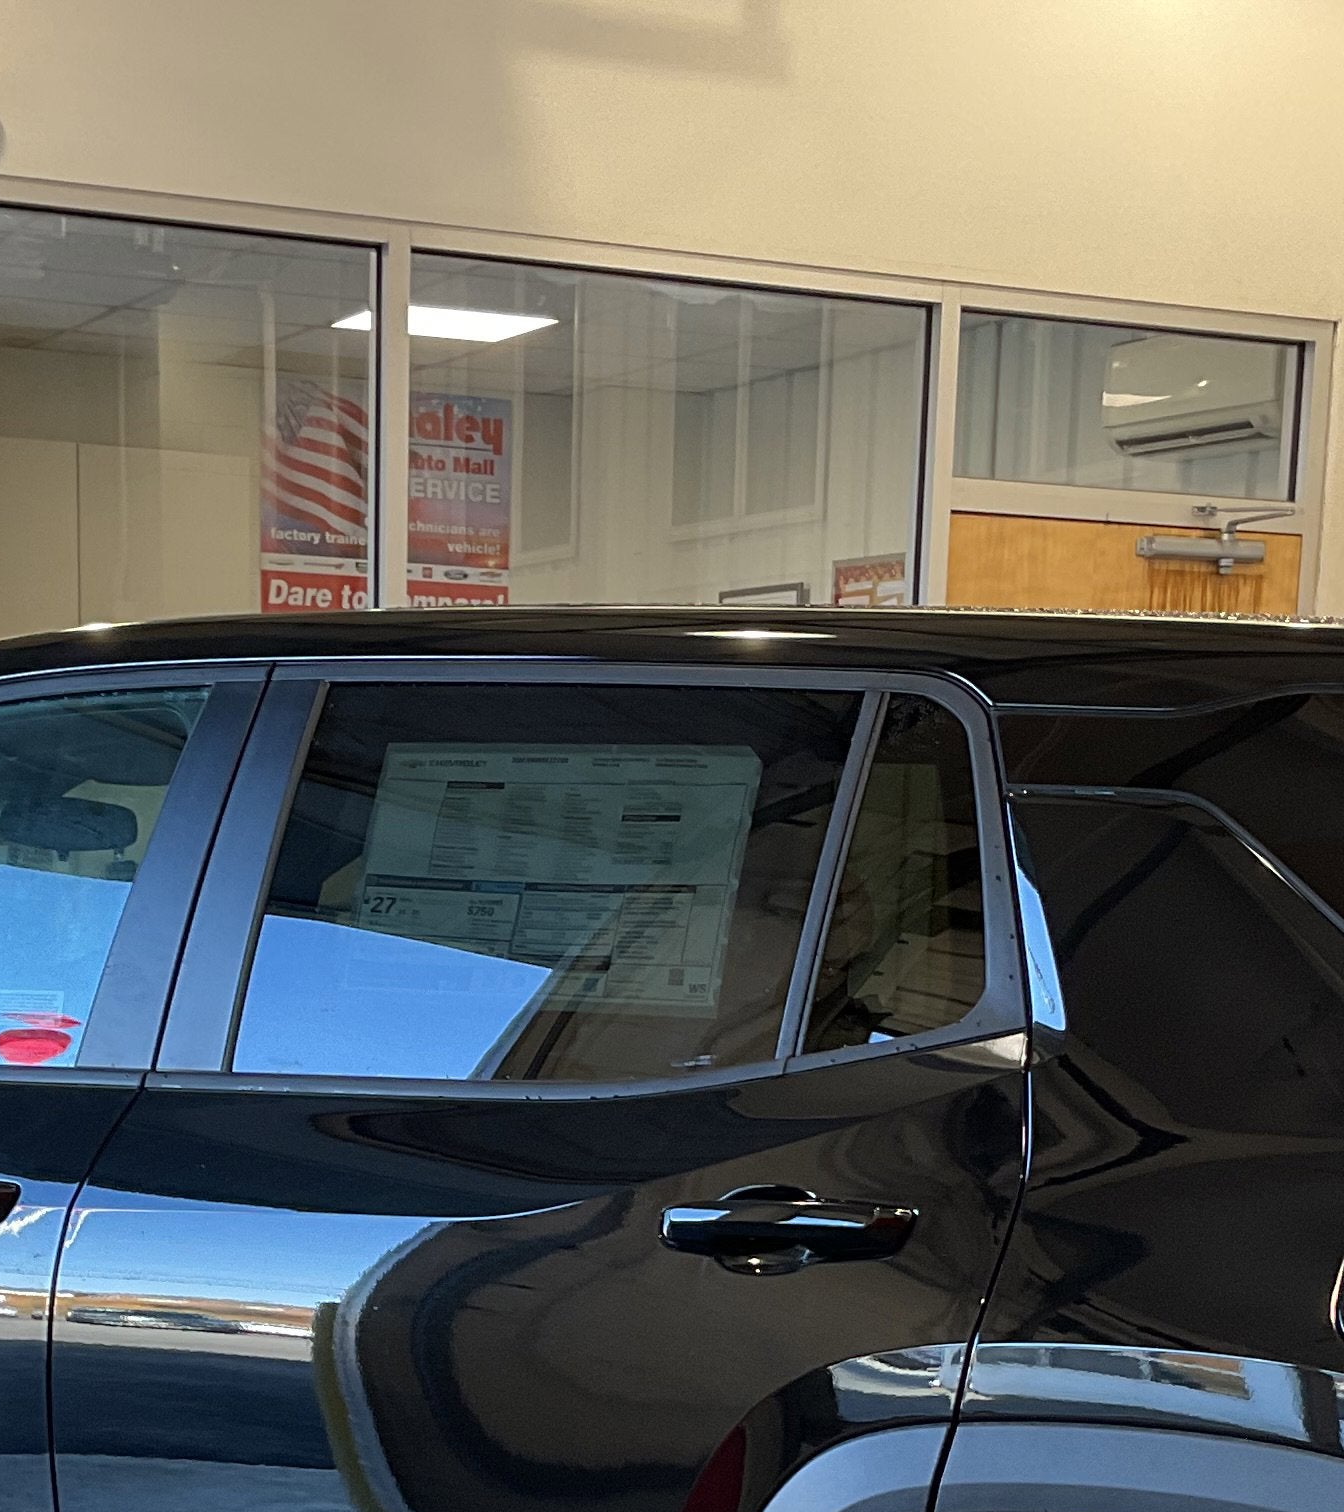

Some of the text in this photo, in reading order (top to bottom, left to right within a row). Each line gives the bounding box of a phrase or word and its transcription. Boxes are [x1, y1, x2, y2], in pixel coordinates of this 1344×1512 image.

[410, 403, 504, 455] aley
[410, 451, 495, 476] uto Mall
[410, 477, 501, 504] ERVICE
[271, 527, 500, 555] factory traine vehicle!
[409, 519, 500, 538] chnicians are
[268, 578, 333, 608] Dare
[341, 584, 368, 610] to
[370, 896, 397, 914] 27
